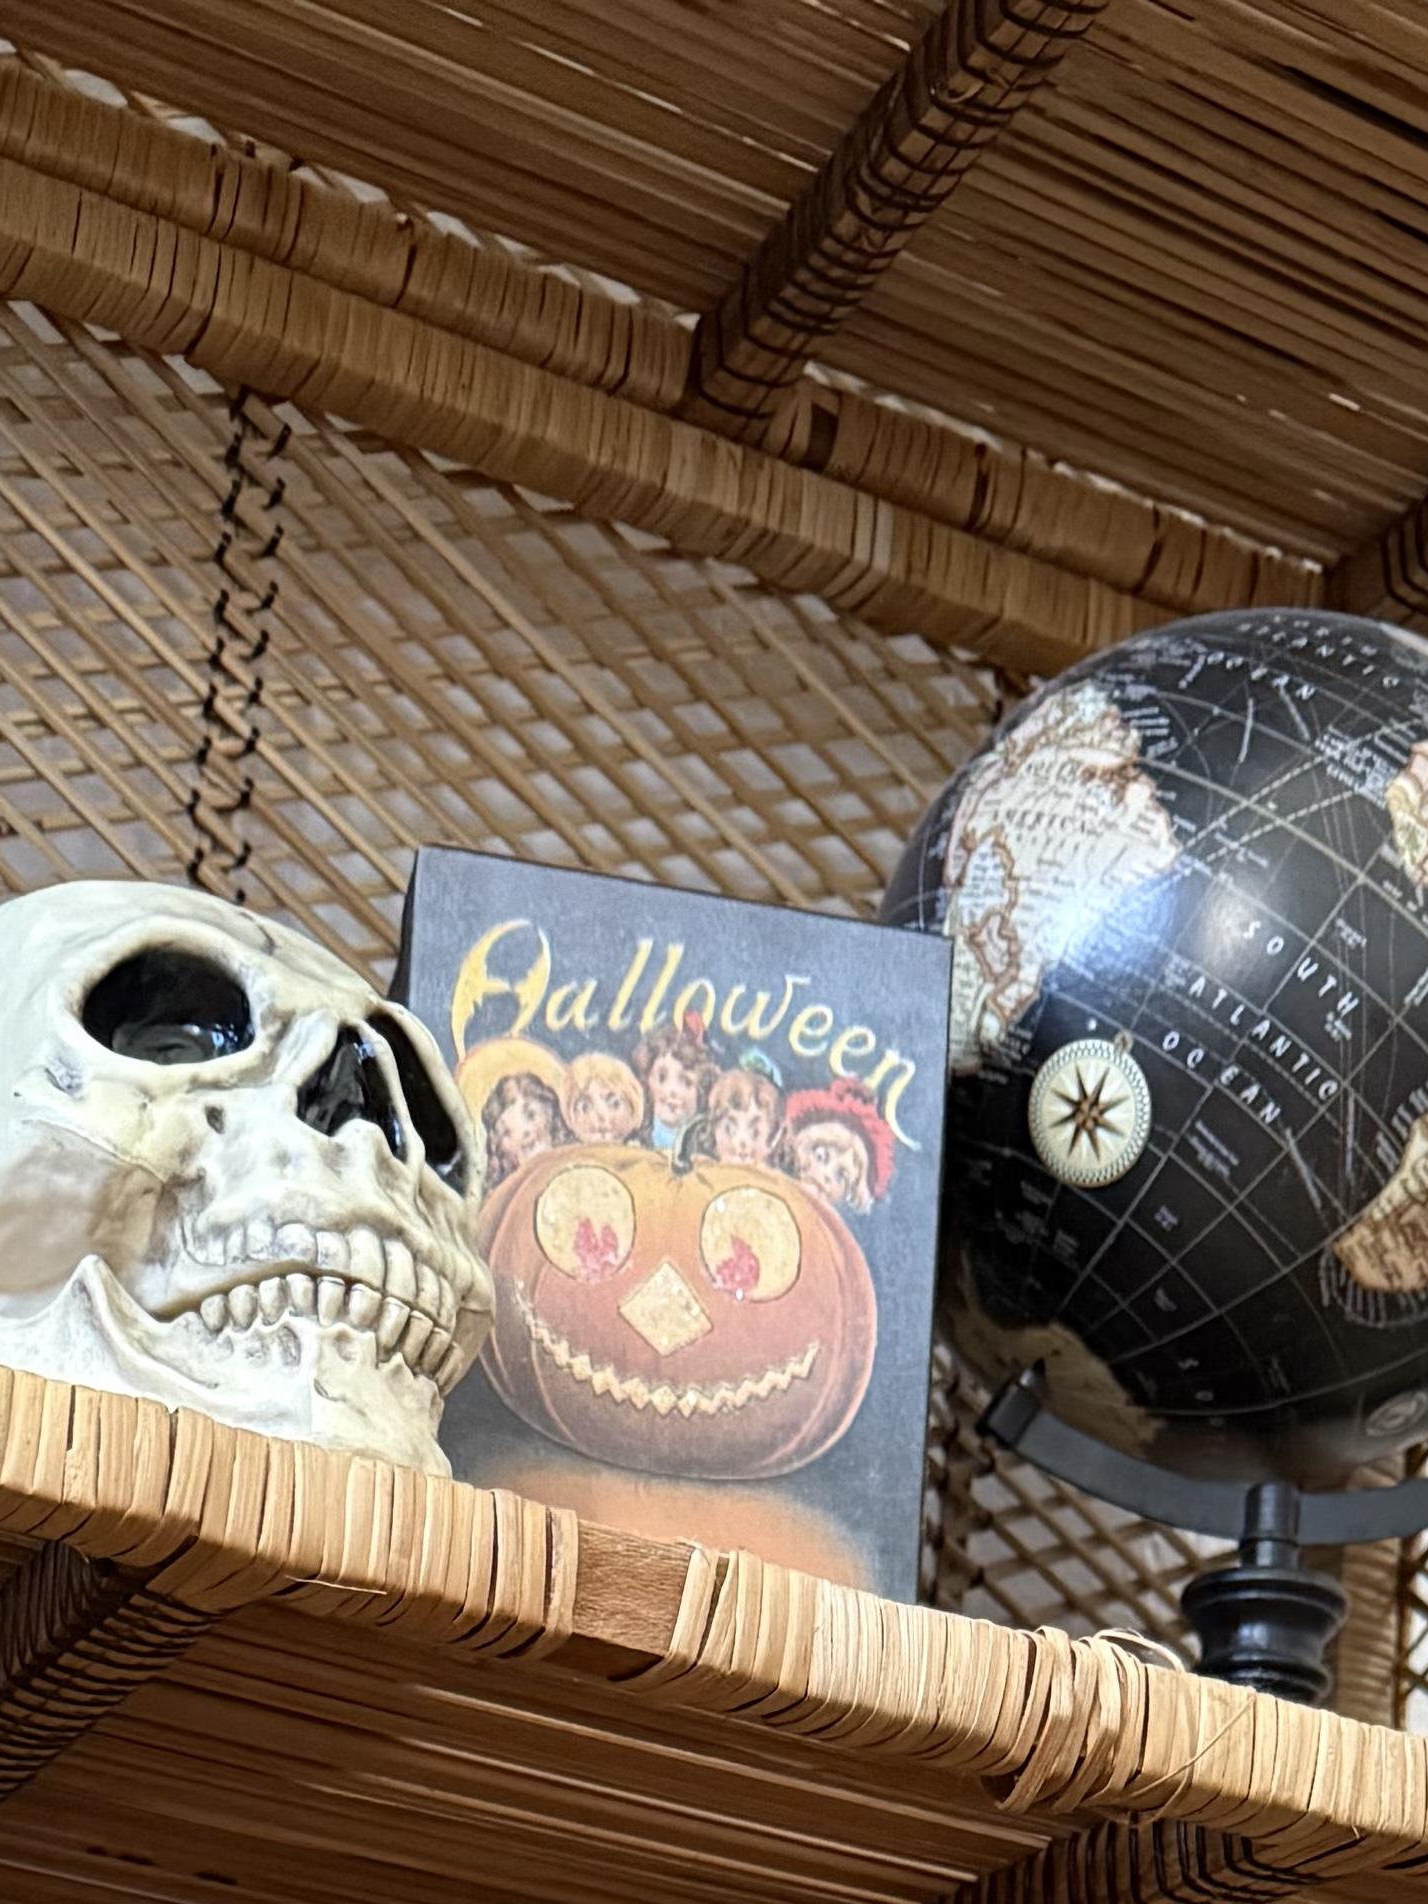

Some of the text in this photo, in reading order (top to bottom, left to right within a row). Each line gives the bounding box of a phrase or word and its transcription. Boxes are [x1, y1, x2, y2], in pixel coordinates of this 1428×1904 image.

[1243, 920, 1360, 1017] SOUTH
[449, 918, 922, 1150] Halloween
[1162, 1031, 1281, 1124] OCEAN
[1189, 975, 1338, 1100] ATLANTIC
